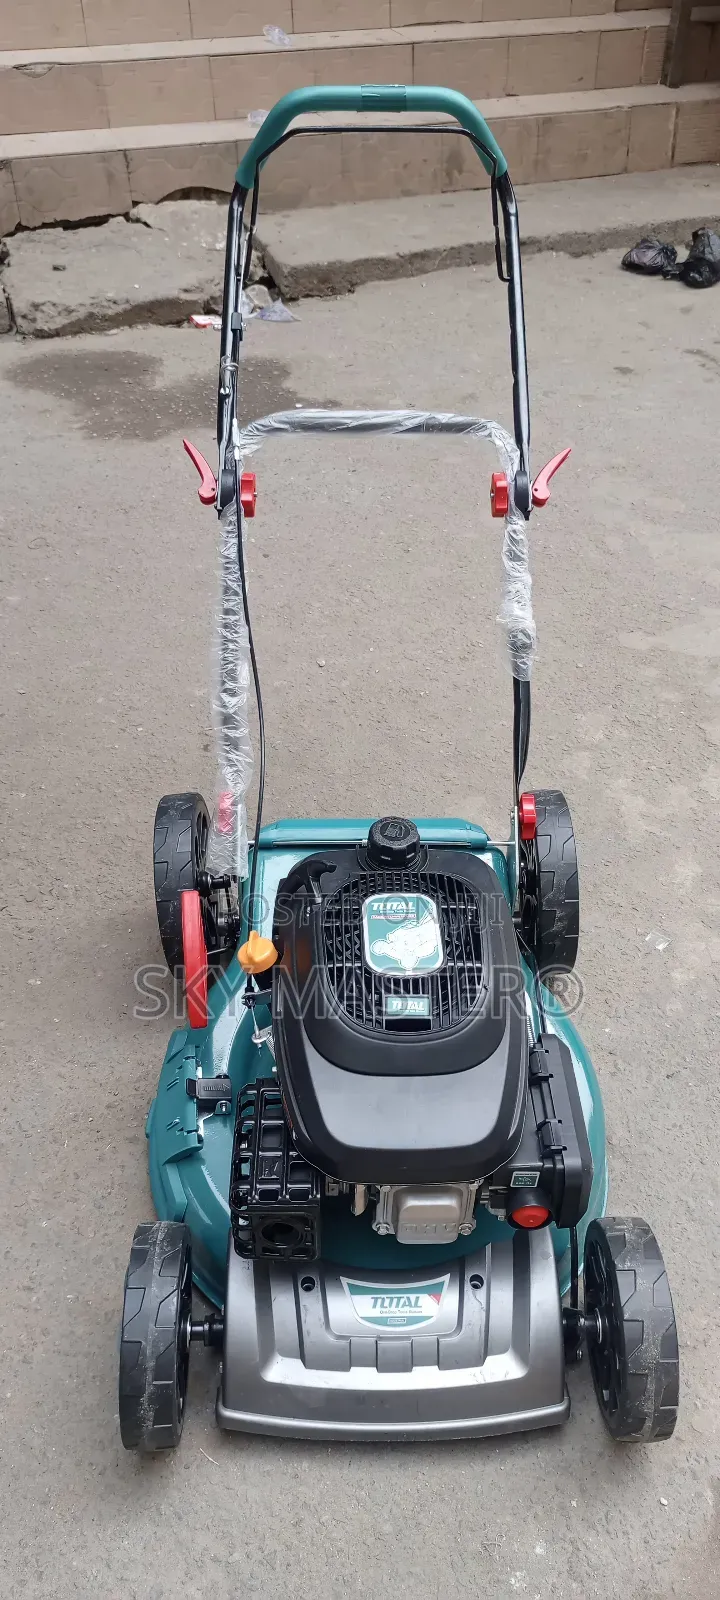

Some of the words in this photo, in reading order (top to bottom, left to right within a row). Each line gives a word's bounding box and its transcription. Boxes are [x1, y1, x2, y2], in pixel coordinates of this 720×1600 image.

[371, 902, 415, 911] TOTAL
[391, 1000, 425, 1010] TOTAL
[371, 1296, 423, 1309] TOTAL
